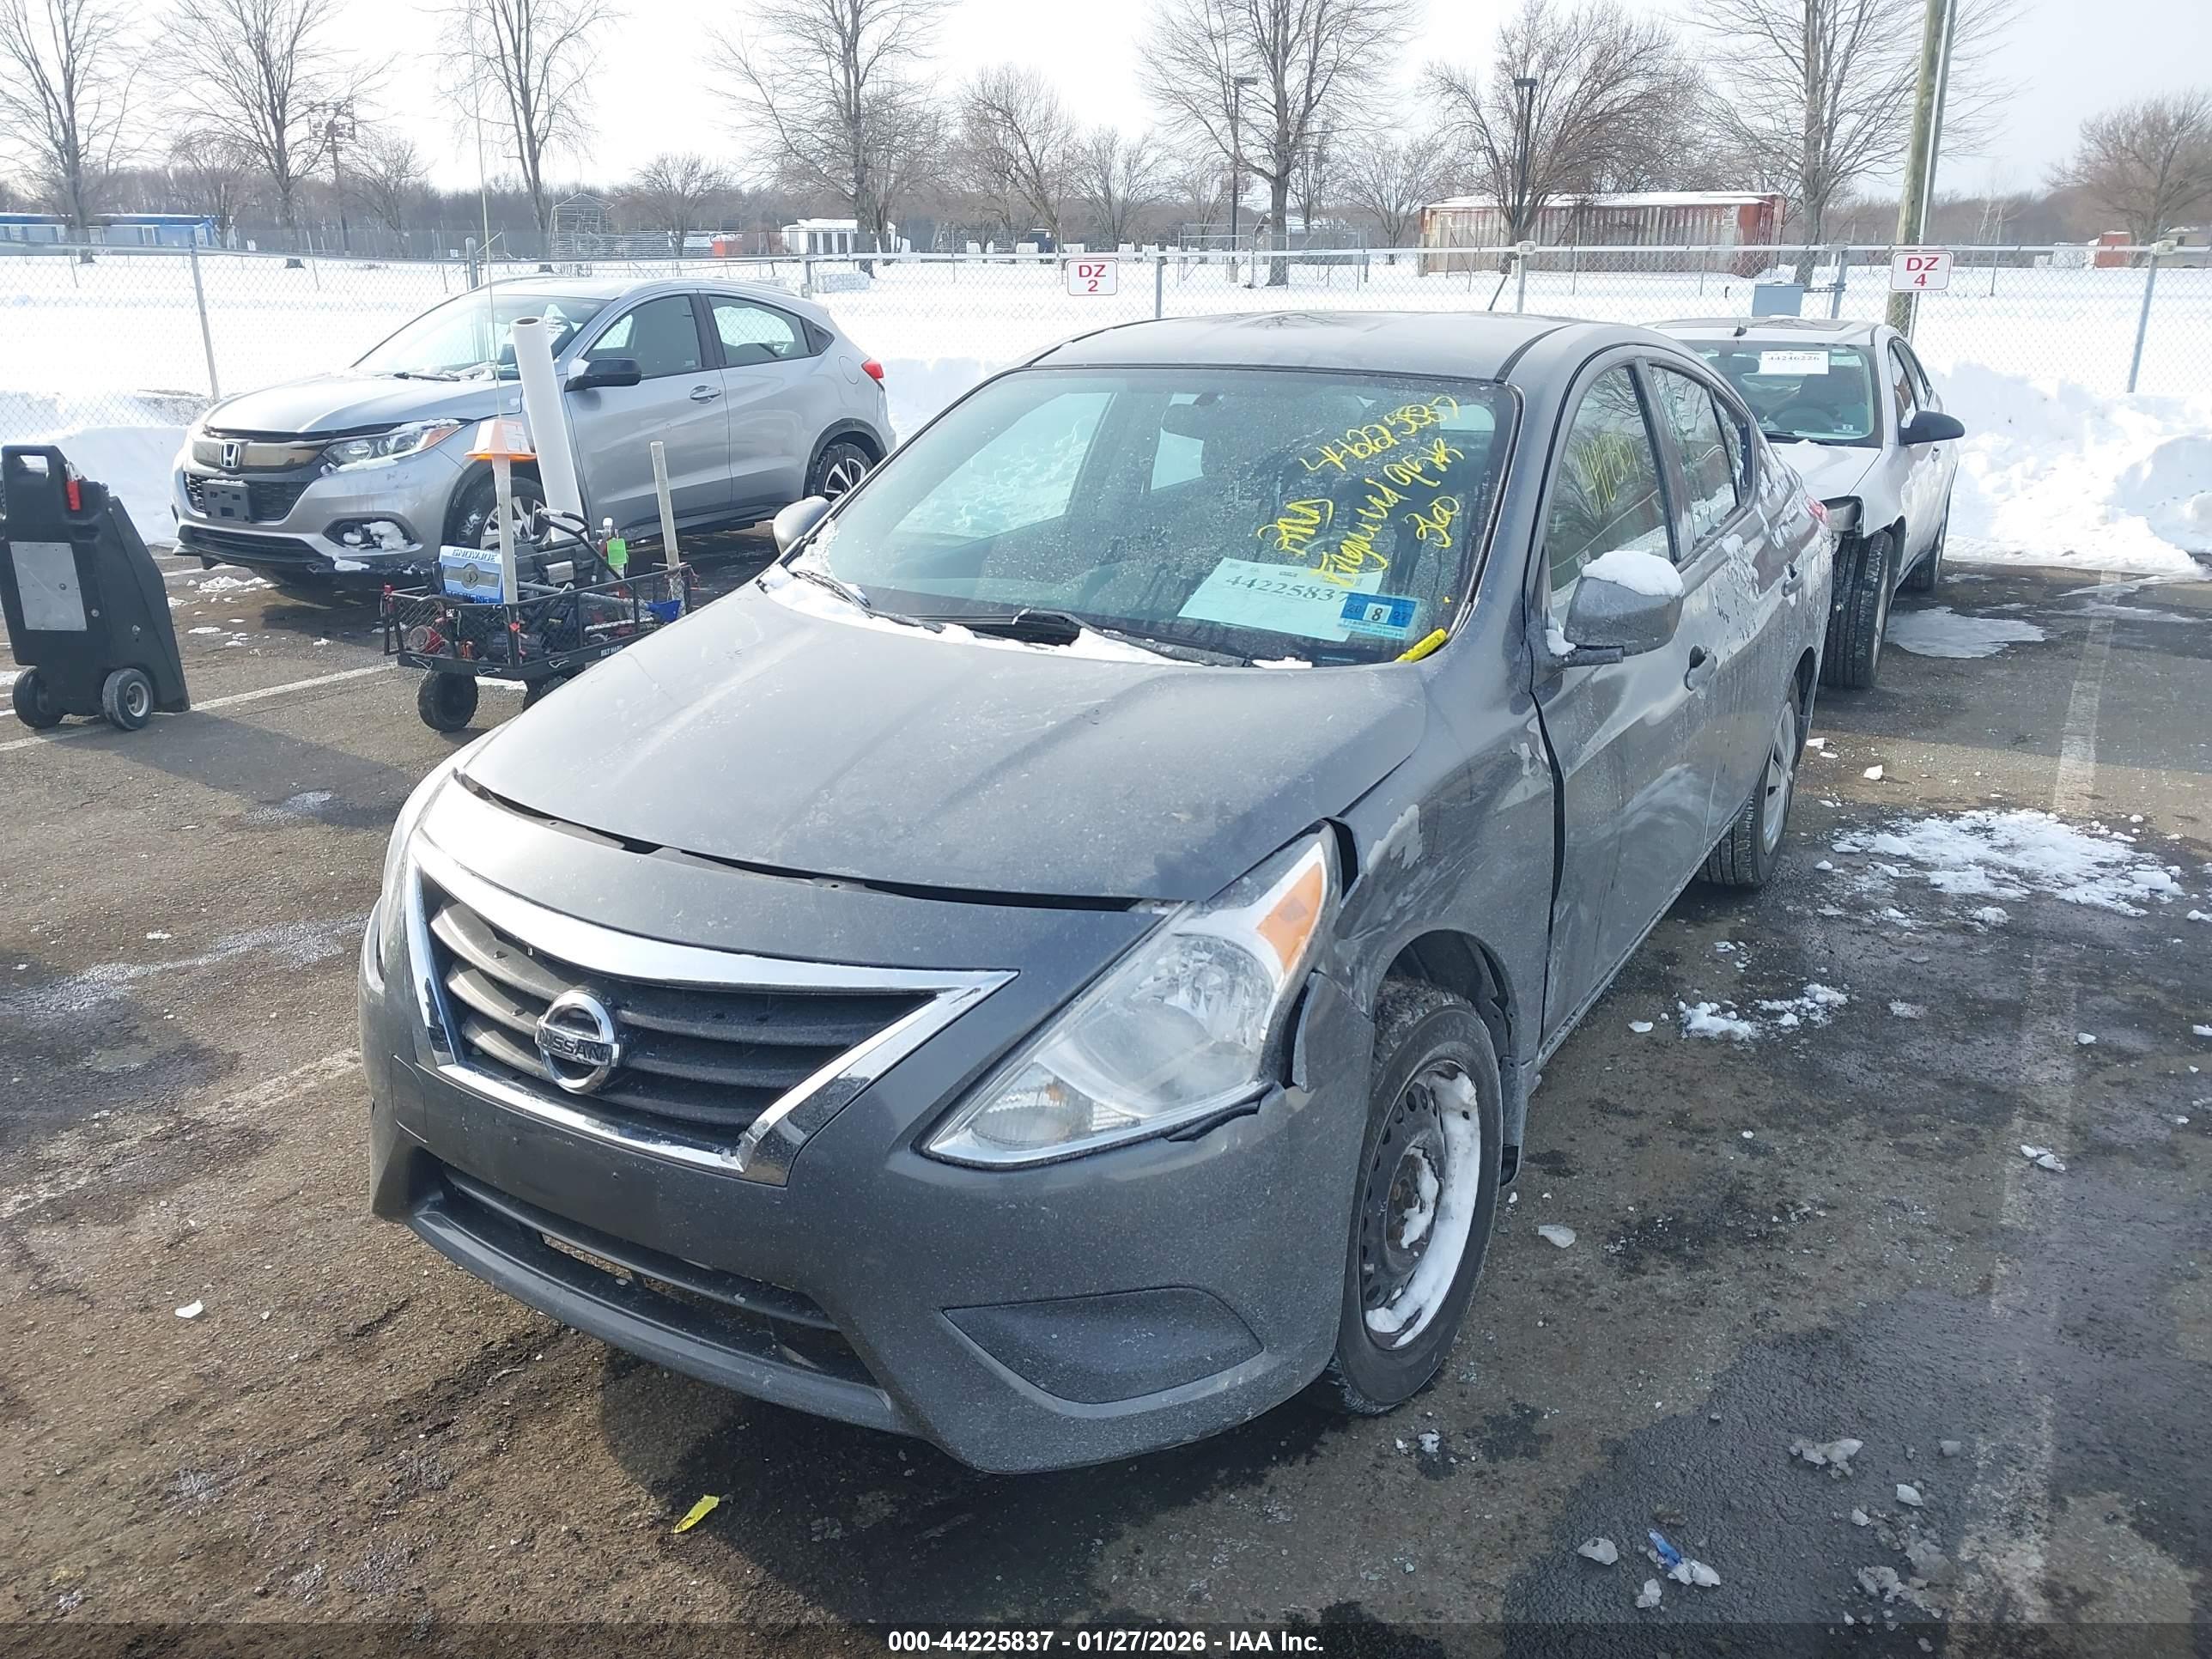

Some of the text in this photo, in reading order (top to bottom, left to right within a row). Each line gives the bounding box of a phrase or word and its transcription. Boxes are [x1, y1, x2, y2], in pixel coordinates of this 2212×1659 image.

[1079, 264, 1106, 277] DZ
[1906, 257, 1940, 271] DZ
[1088, 280, 1098, 292] 2
[1913, 273, 1928, 286] 4
[1370, 607, 1383, 621] 8
[538, 1027, 610, 1063] NISSAN
